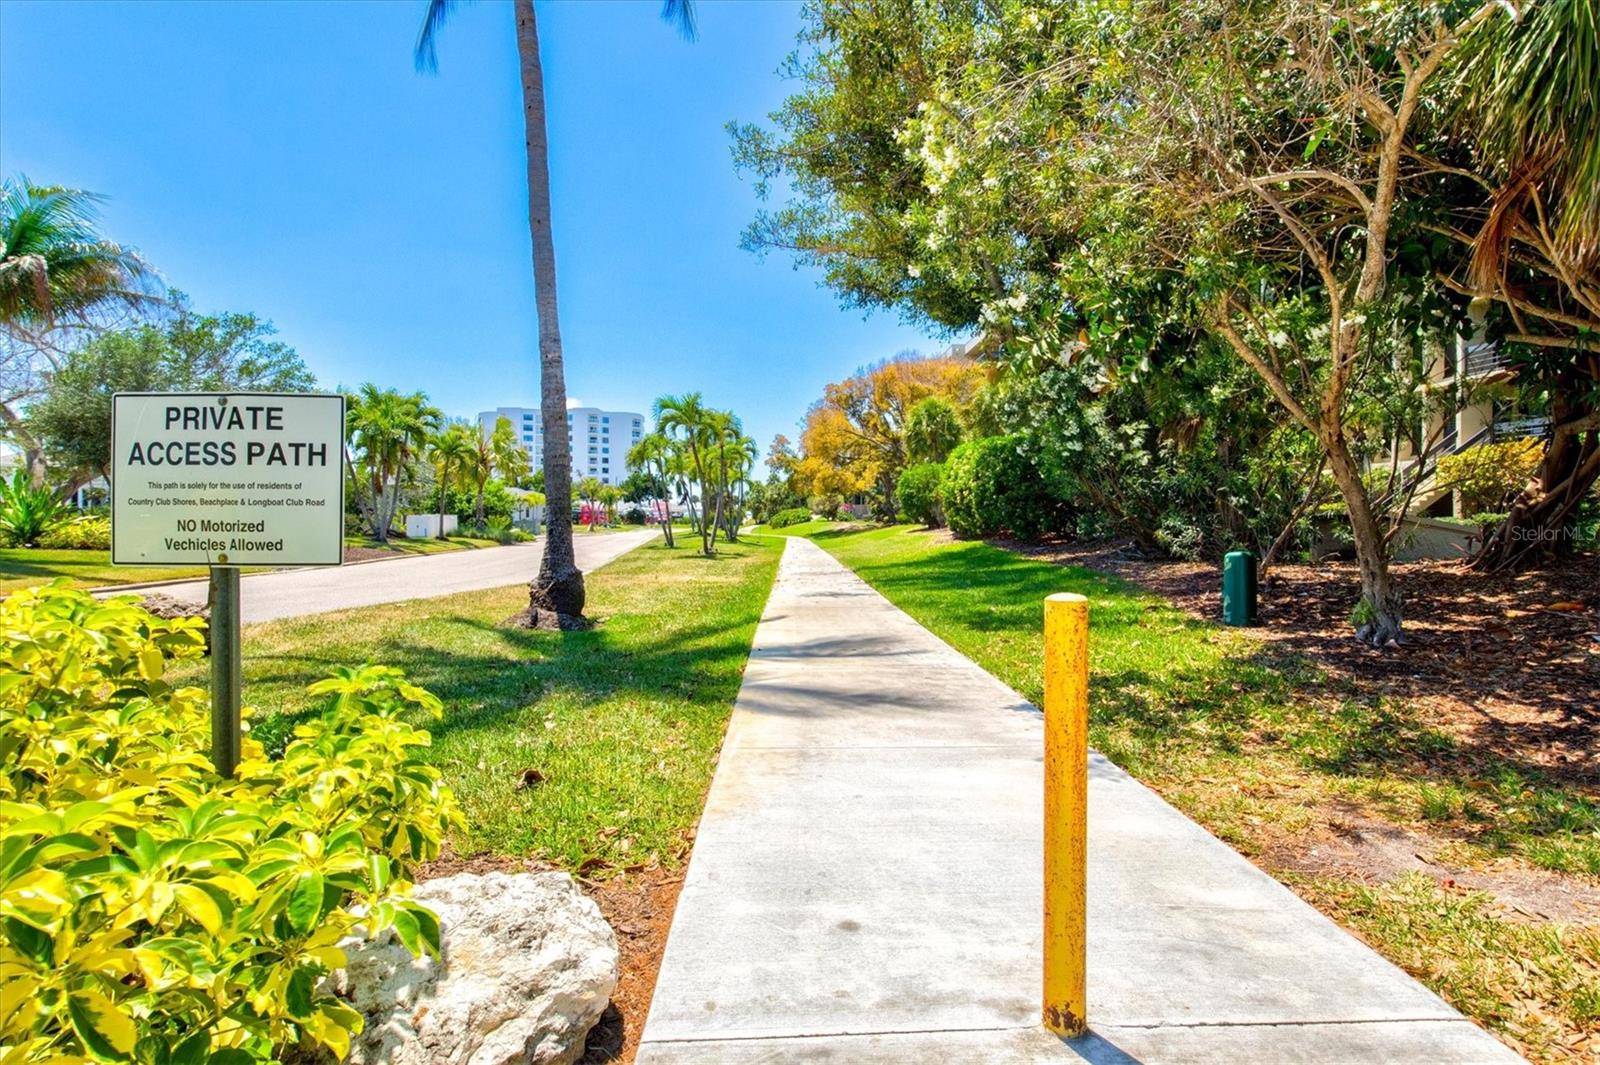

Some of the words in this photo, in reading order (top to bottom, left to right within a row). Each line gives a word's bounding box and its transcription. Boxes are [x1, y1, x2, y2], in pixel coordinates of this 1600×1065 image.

[165, 406, 283, 430] PRIVATE
[128, 442, 236, 465] ACCESS
[247, 442, 326, 466] PATH
[164, 482, 178, 492] path
[188, 482, 207, 492] solely
[247, 482, 255, 490] of
[257, 482, 292, 490] residents
[294, 482, 302, 490] of
[128, 498, 153, 507] Country
[156, 498, 170, 506] Club
[173, 498, 198, 507] Shores,
[200, 498, 238, 508] Beachplace
[248, 499, 284, 508] Longboat
[177, 520, 196, 532] NO
[201, 520, 264, 532] Motorized
[165, 539, 226, 551] Vechicles
[230, 539, 283, 551] Allowed
